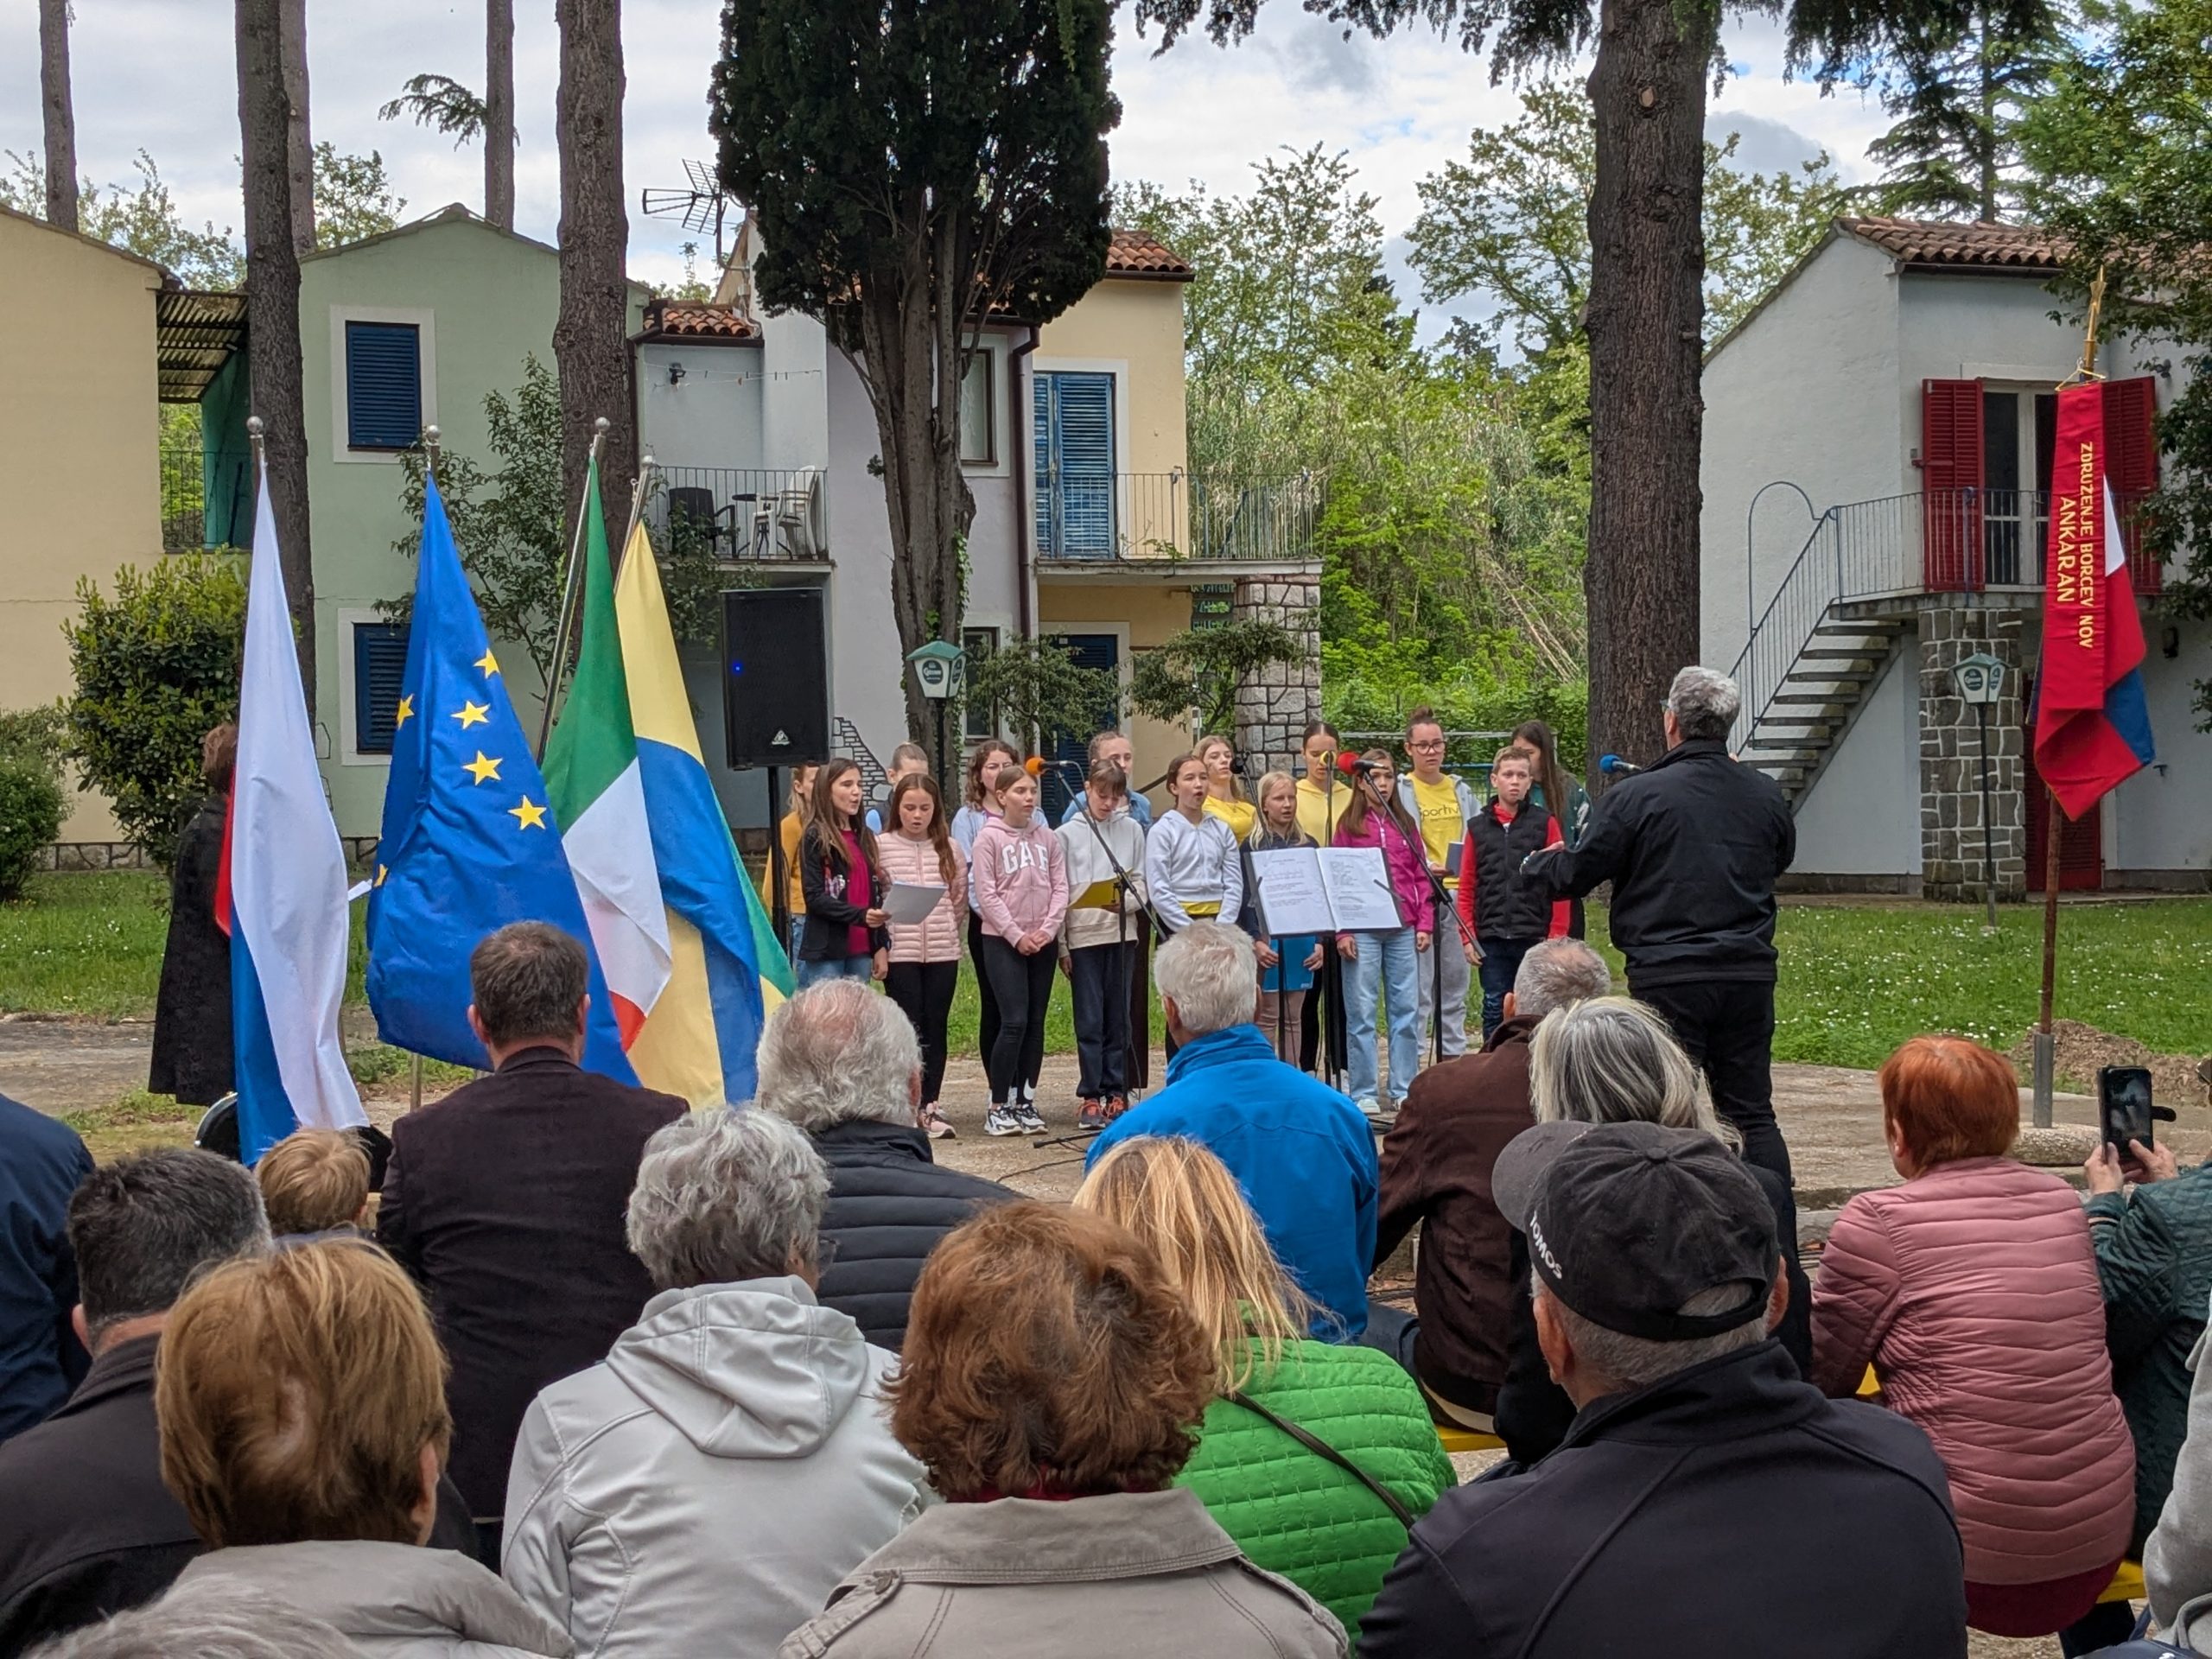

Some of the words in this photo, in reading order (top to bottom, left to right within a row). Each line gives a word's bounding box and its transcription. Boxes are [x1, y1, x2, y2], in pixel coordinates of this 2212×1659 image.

[2056, 496, 2076, 602] ANKARAN
[2080, 543, 2094, 608] BORCEV
[2078, 615, 2094, 648] NOV
[1529, 1210, 1562, 1280] TOMOS
